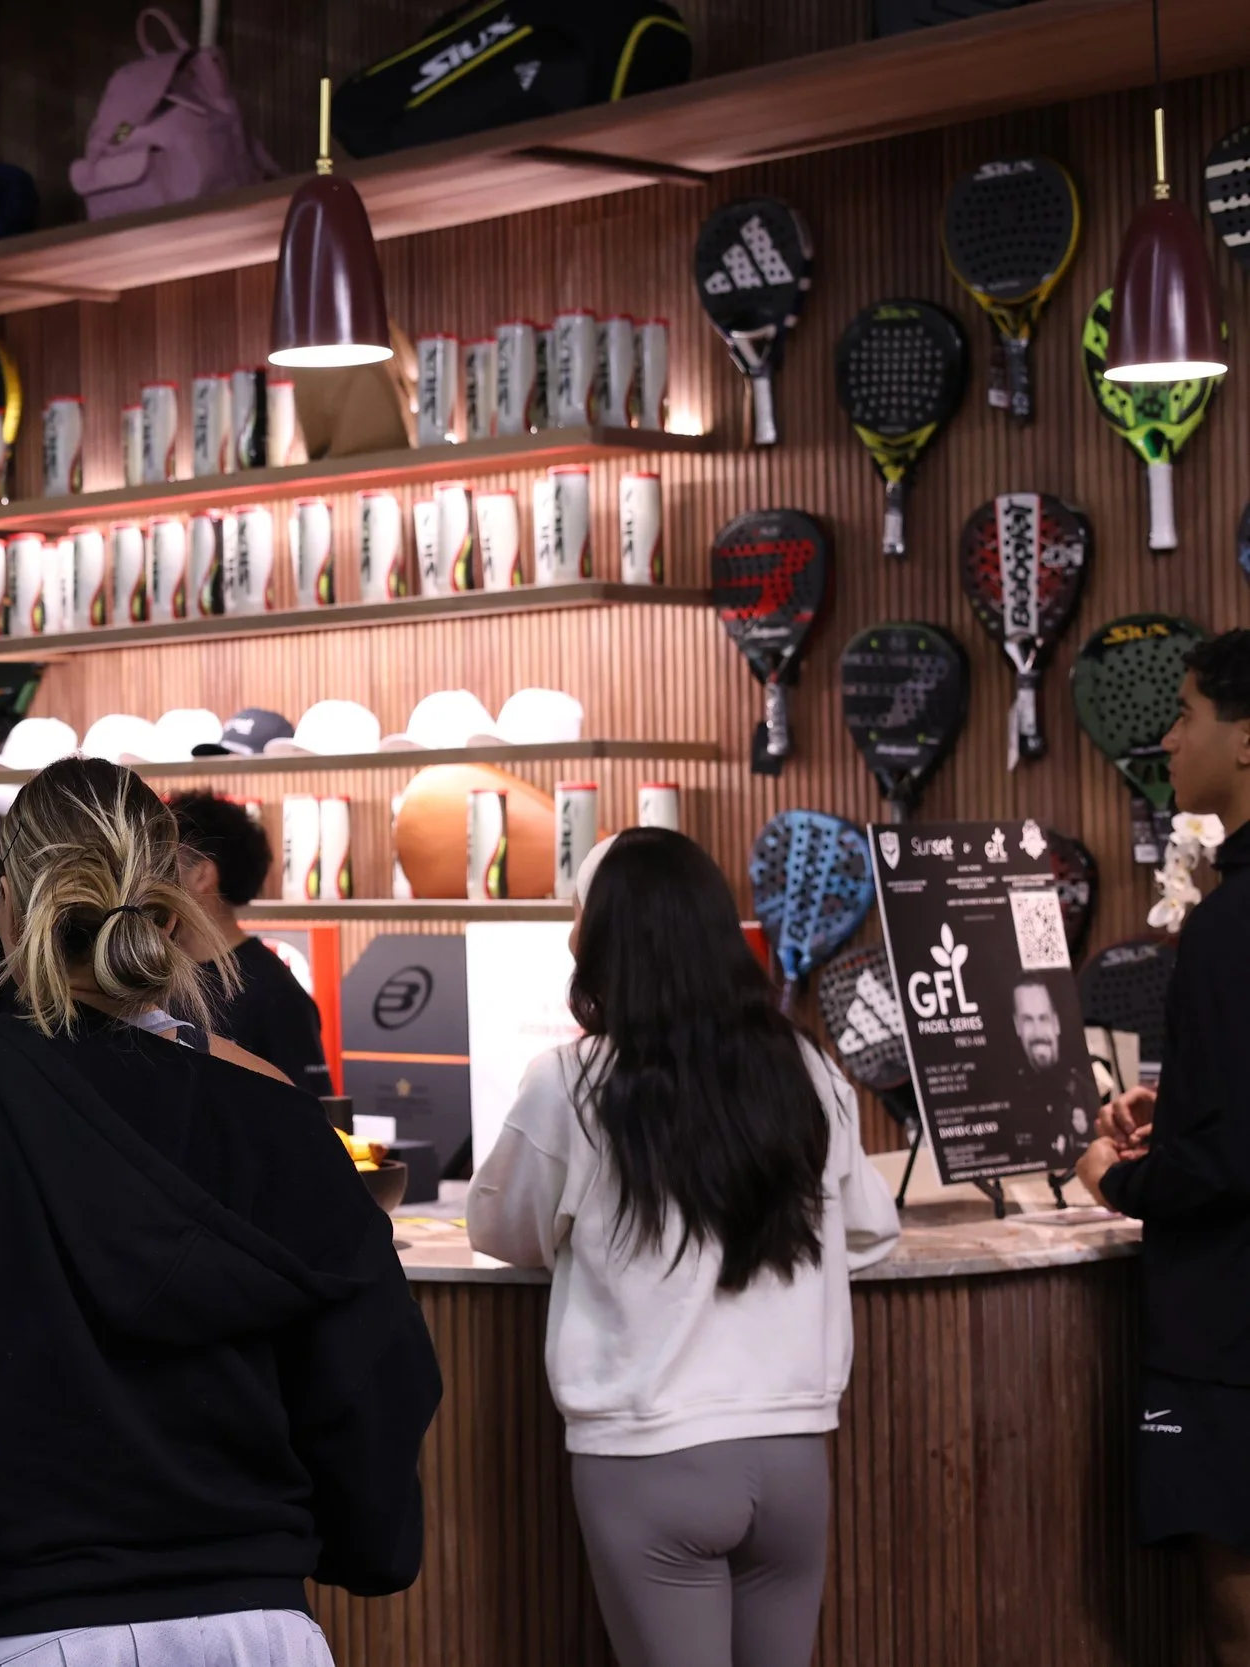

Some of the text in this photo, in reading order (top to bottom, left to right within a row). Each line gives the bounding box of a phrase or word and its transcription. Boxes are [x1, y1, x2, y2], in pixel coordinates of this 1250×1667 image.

[910, 835, 954, 857] Sunset
[907, 960, 979, 1018] GFL
[918, 1016, 984, 1036] PADEL SERIES
